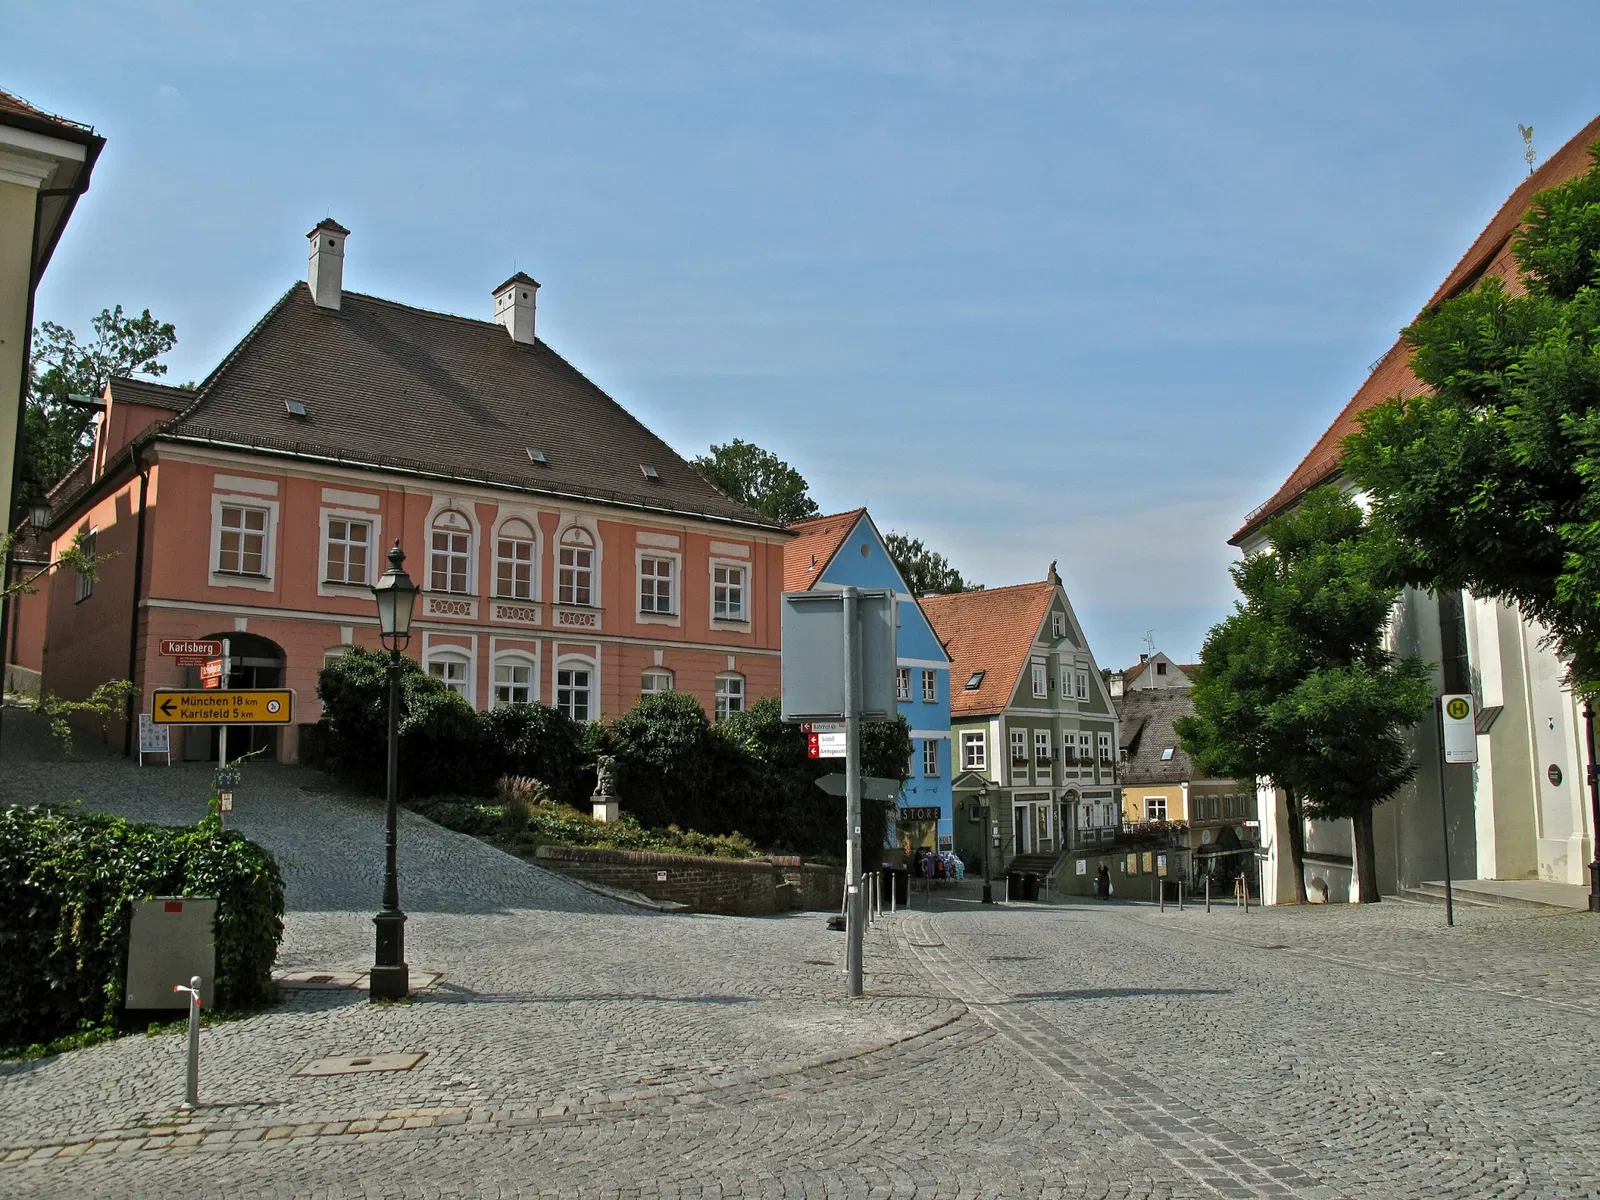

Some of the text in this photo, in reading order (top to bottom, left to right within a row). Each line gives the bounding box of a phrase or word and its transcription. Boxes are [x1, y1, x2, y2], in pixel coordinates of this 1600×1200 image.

[169, 642, 213, 655] Karlsberg
[181, 696, 258, 706] München 18 km
[181, 709, 230, 719] Karlsfeld
[233, 709, 239, 718] 5
[1452, 703, 1464, 715] H
[903, 808, 939, 820] STORE
